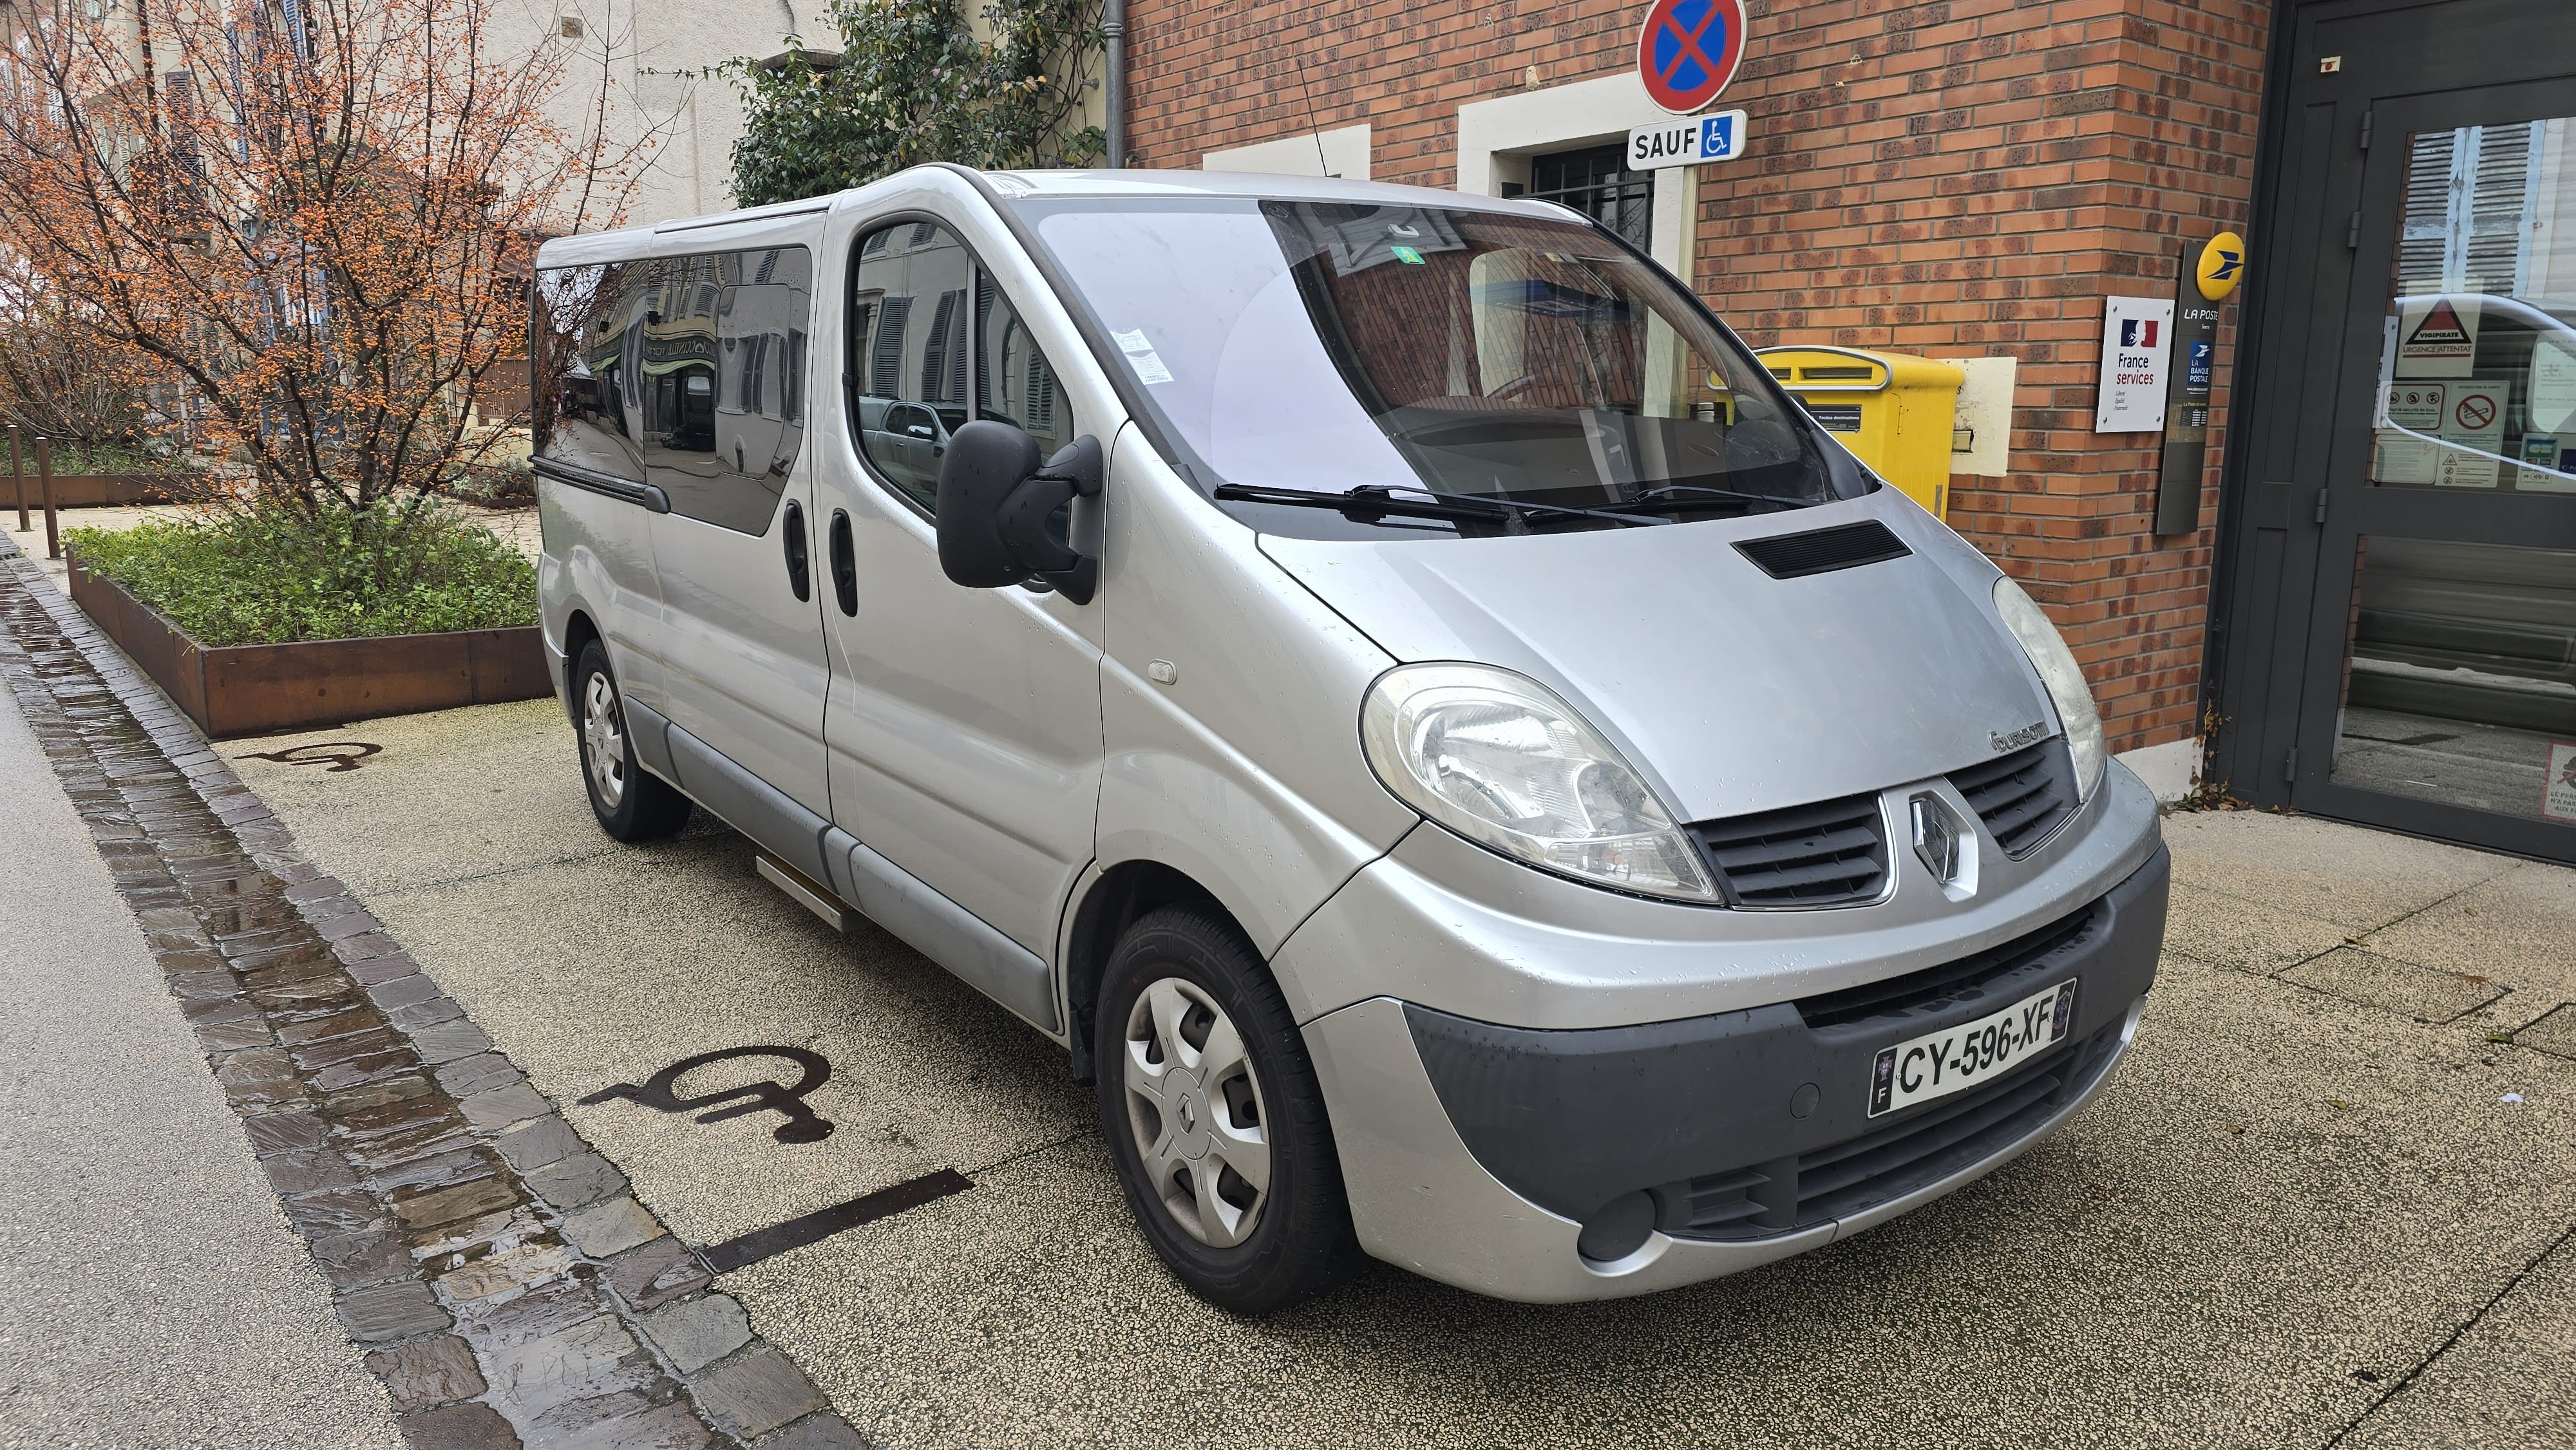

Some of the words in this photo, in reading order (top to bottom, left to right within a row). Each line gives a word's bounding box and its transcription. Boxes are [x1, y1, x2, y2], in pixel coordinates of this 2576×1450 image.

[1634, 127, 1696, 159] SAUF
[2184, 308, 2198, 319] LA
[2199, 309, 2219, 321] POSTE
[2118, 353, 2149, 368] France
[2116, 369, 2154, 385] services
[1899, 995, 2054, 1093] CY-596-XF
[1877, 1086, 1887, 1104] F
